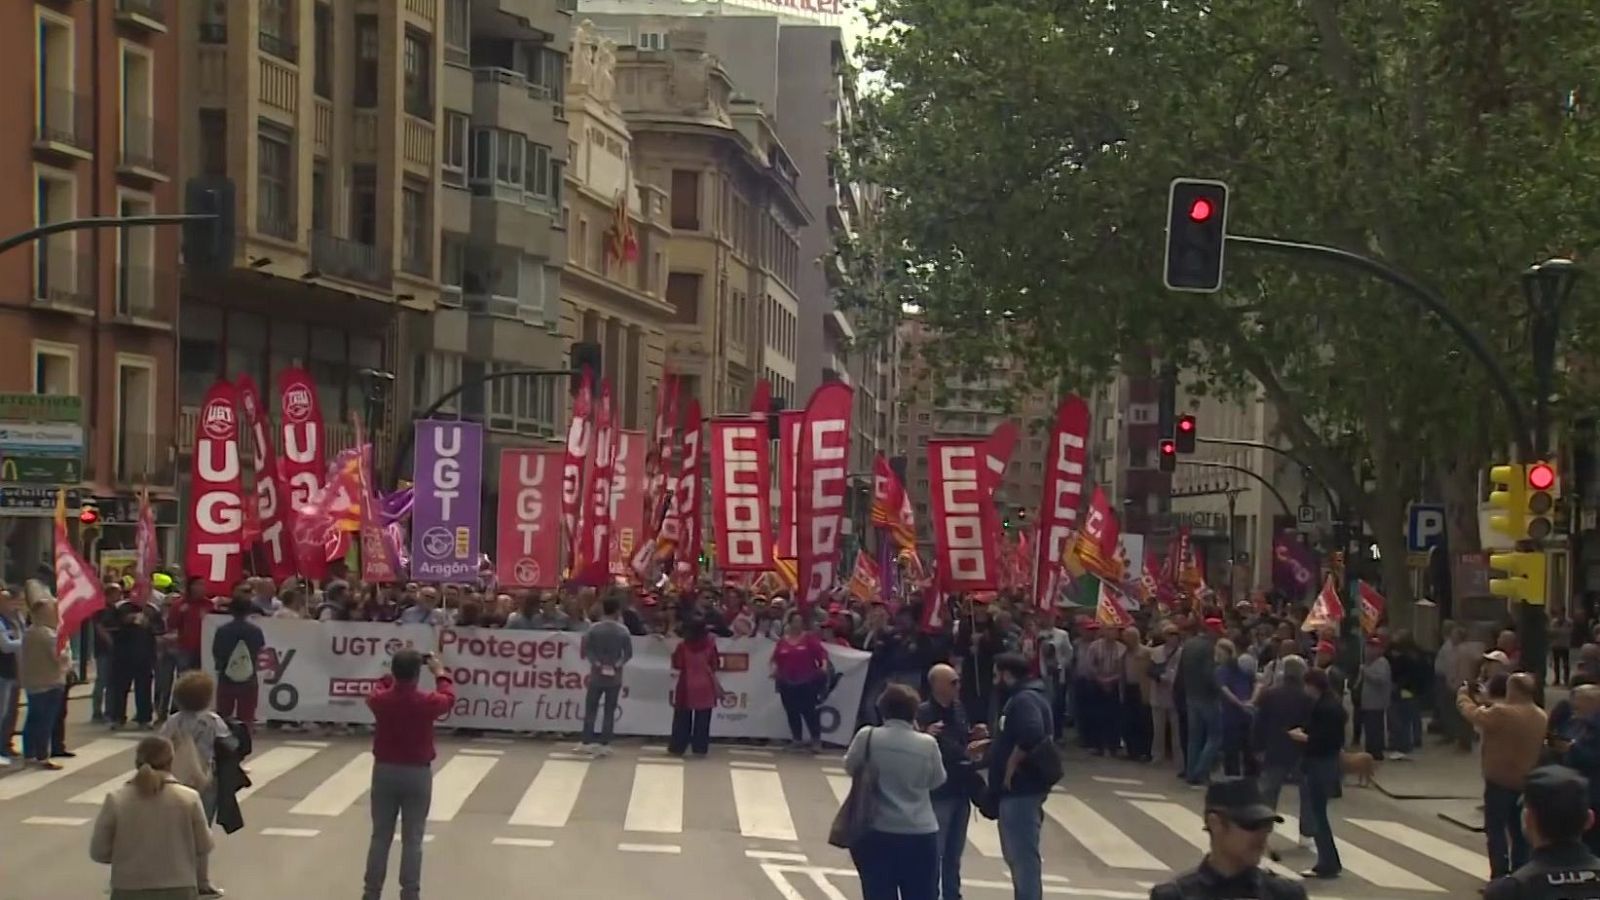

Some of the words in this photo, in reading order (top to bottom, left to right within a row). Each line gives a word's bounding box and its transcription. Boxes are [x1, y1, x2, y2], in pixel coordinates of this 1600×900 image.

[196, 440, 242, 582] UGT
[433, 427, 461, 521] UGT
[516, 455, 545, 555] UGT
[722, 427, 763, 564] CCOO
[808, 419, 845, 602] CCOO
[940, 446, 987, 580] CCOO
[420, 561, 469, 576] Aragón
[1417, 510, 1443, 547] P
[332, 636, 381, 656] UGT
[333, 681, 377, 694] CCO
[438, 629, 568, 664] Proteger
